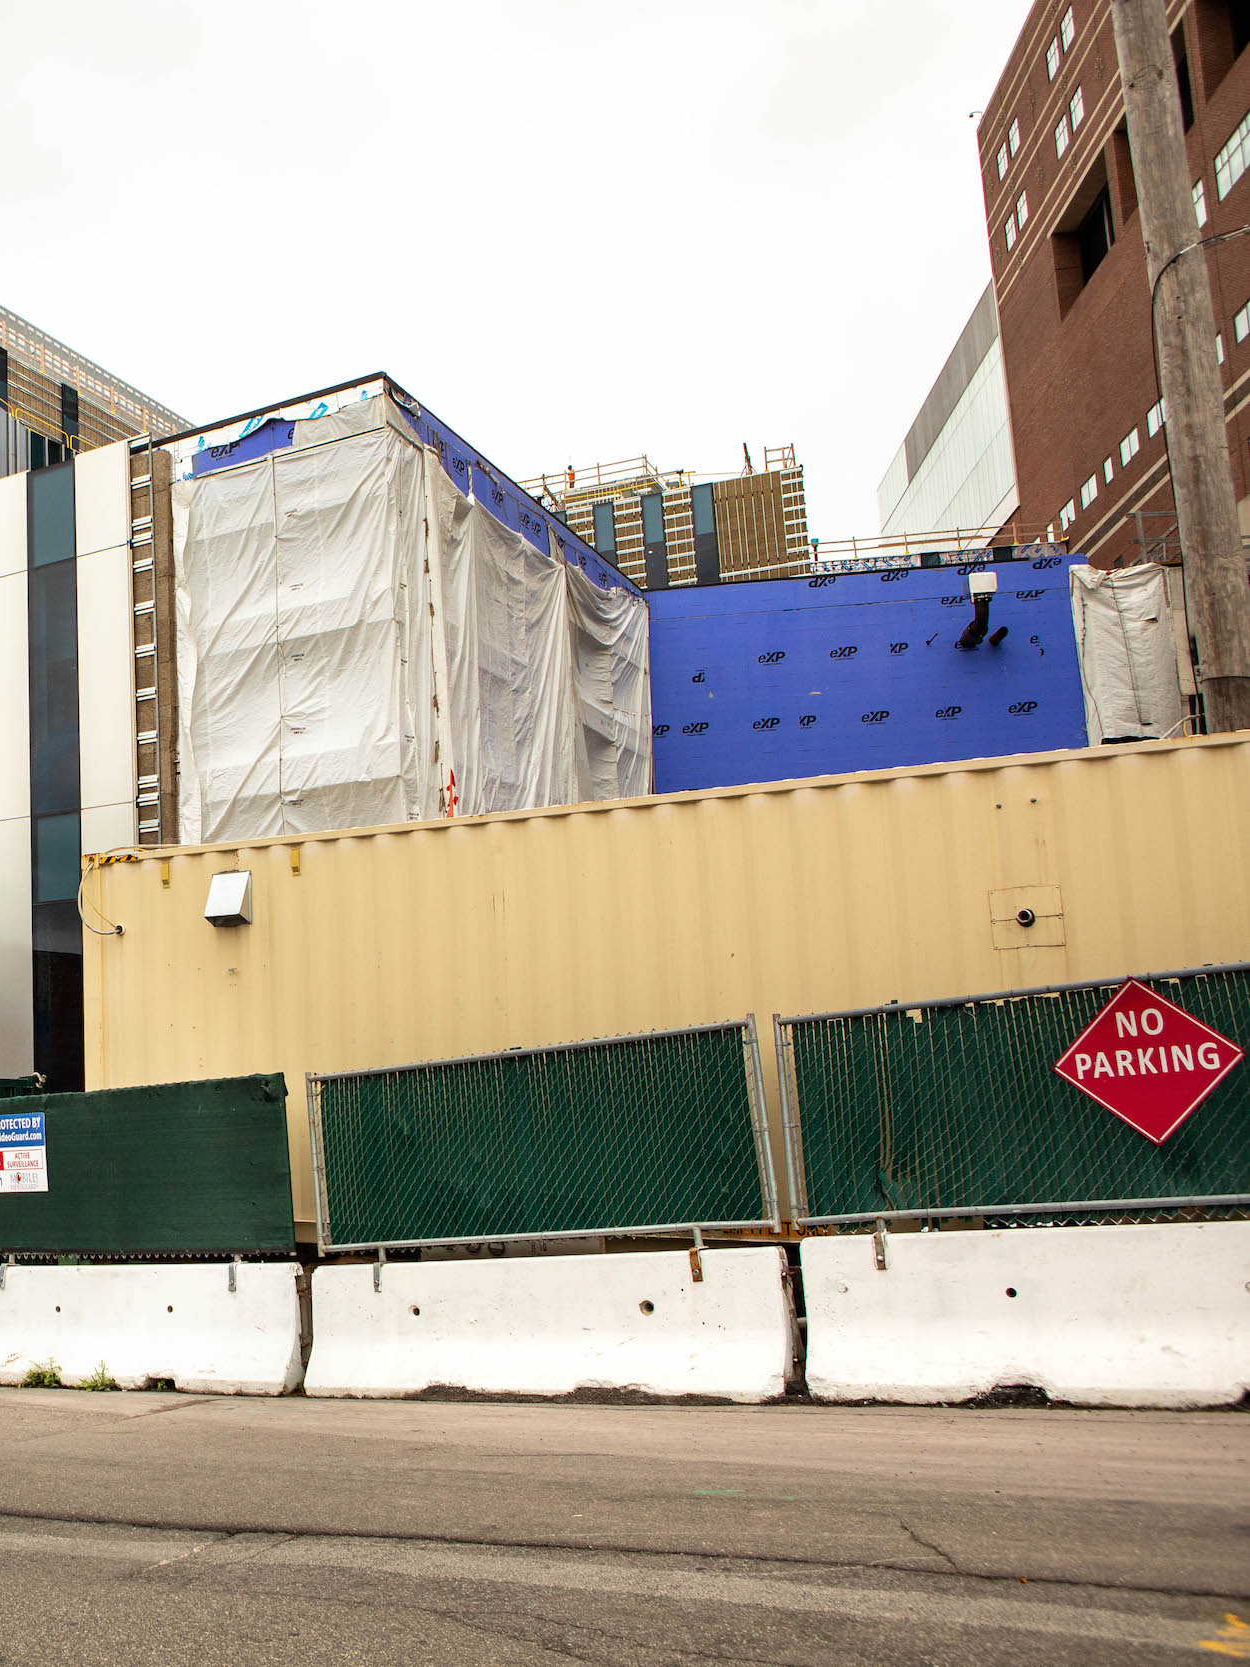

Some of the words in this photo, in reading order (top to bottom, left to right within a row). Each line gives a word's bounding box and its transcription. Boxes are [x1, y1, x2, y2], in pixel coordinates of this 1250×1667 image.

[758, 651, 786, 664] eXP
[830, 646, 858, 659] eXP
[935, 706, 962, 718] eXP
[1008, 701, 1038, 714] eXP
[861, 710, 890, 723] eXP
[682, 722, 709, 734] eXP
[752, 717, 781, 730] eXP
[1115, 1008, 1164, 1039] NO
[1074, 1041, 1221, 1080] PARKING
[32, 1117, 41, 1128] BY
[7, 1160, 39, 1168] SURVEILLANCE
